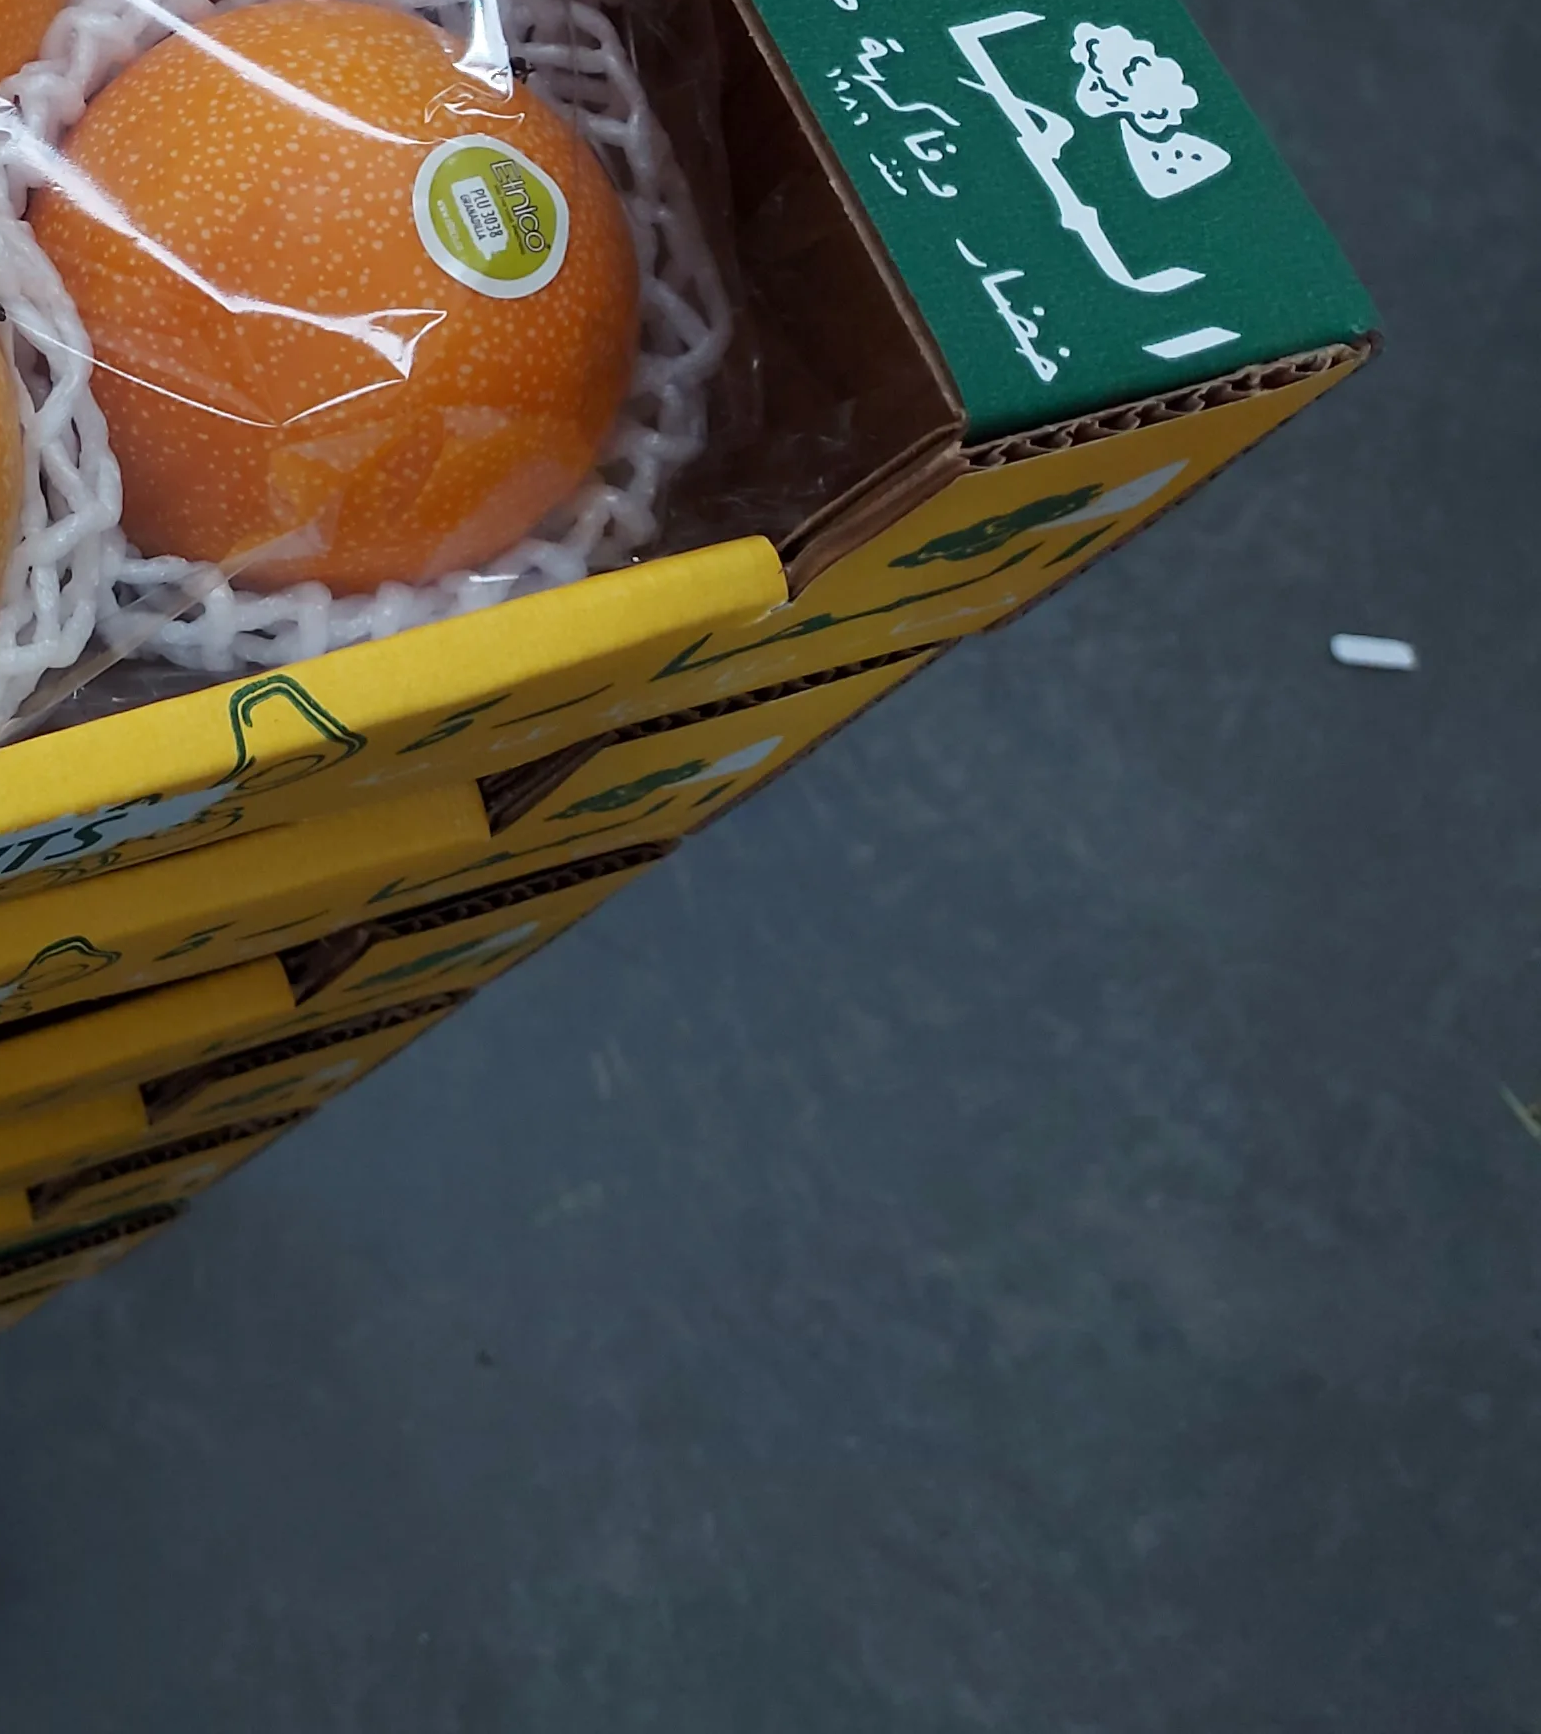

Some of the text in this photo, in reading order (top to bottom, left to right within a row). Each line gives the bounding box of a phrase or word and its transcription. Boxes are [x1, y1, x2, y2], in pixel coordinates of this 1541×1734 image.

[857, 35, 961, 198] وفاكهة
[460, 194, 486, 241] GRANADILLA
[470, 188, 504, 239] PLU 3038
[490, 158, 545, 252] Etnico
[955, 239, 1071, 383] خضار
